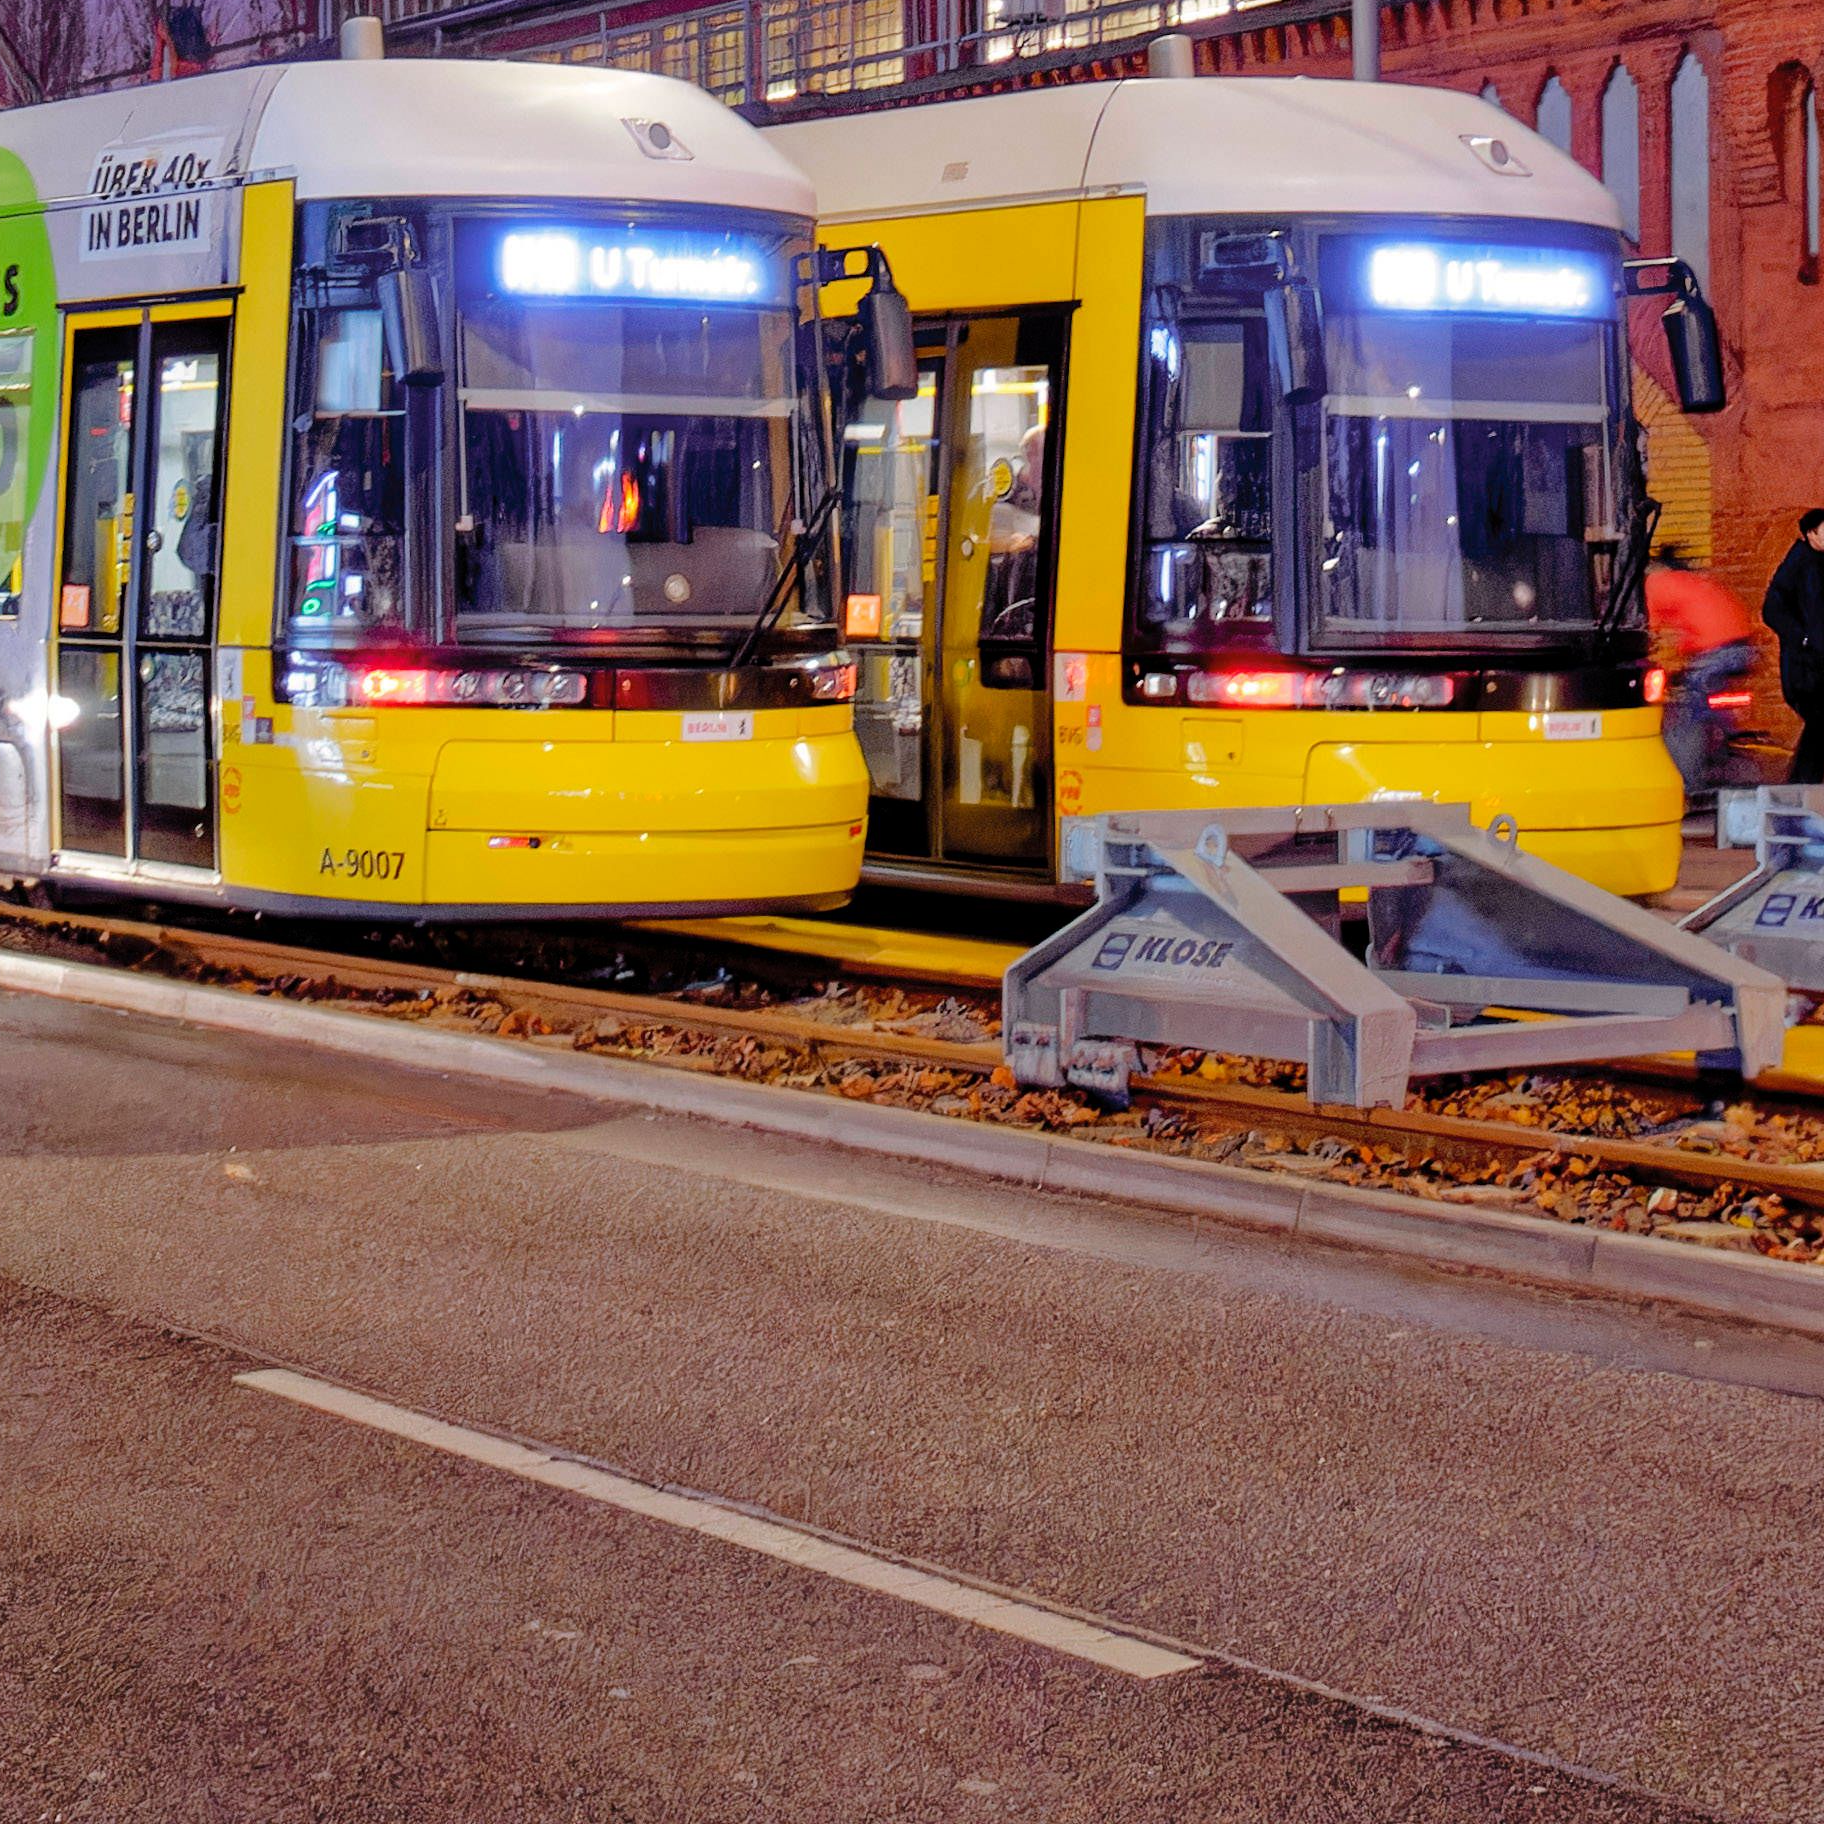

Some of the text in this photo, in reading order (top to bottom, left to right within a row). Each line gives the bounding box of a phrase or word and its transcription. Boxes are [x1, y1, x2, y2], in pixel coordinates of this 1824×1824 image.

[92, 154, 159, 200] ÜBER
[88, 198, 202, 252] IN BERLIN
[320, 847, 406, 880] A-9007
[1135, 936, 1235, 969] KLOSE
